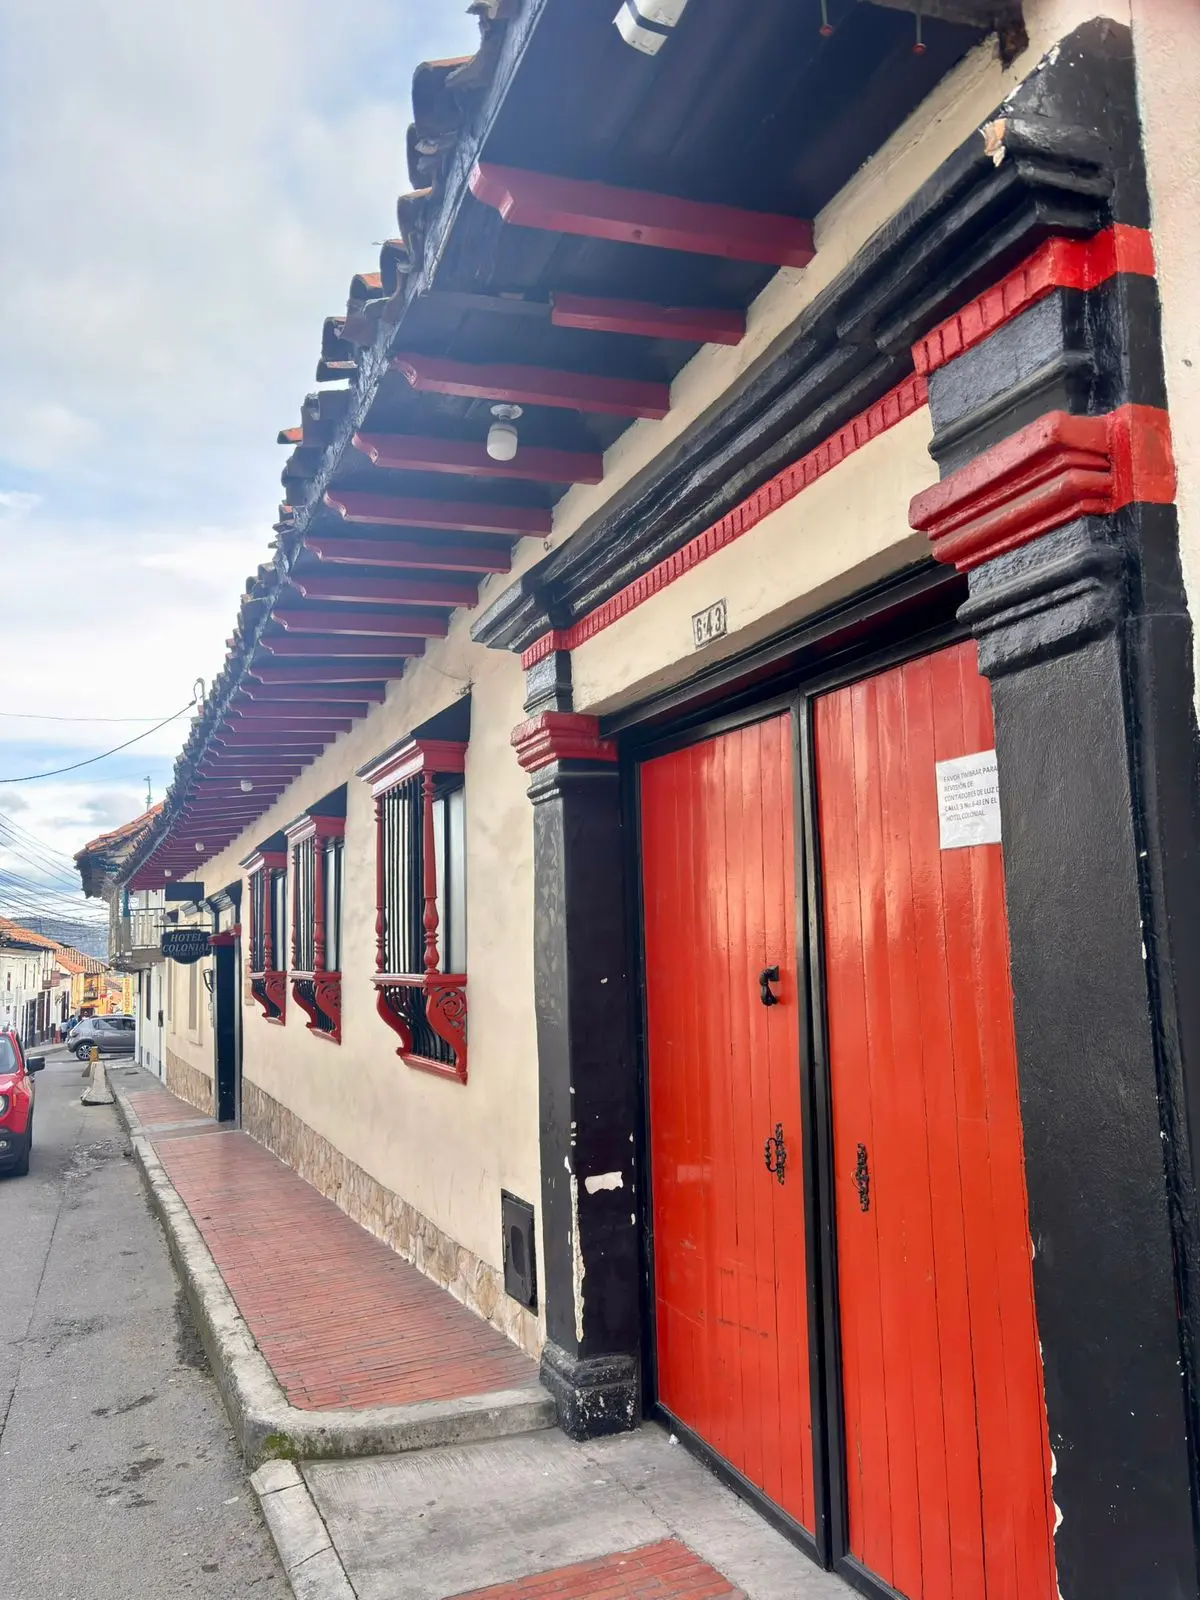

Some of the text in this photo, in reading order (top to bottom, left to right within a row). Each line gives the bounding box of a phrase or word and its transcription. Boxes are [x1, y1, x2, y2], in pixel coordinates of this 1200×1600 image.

[982, 765, 998, 774] PARA
[944, 790, 976, 801] CONTADORES
[944, 803, 960, 811] CALLE
[170, 933, 203, 942] HOTEL
[162, 943, 210, 953] COLONIAL
